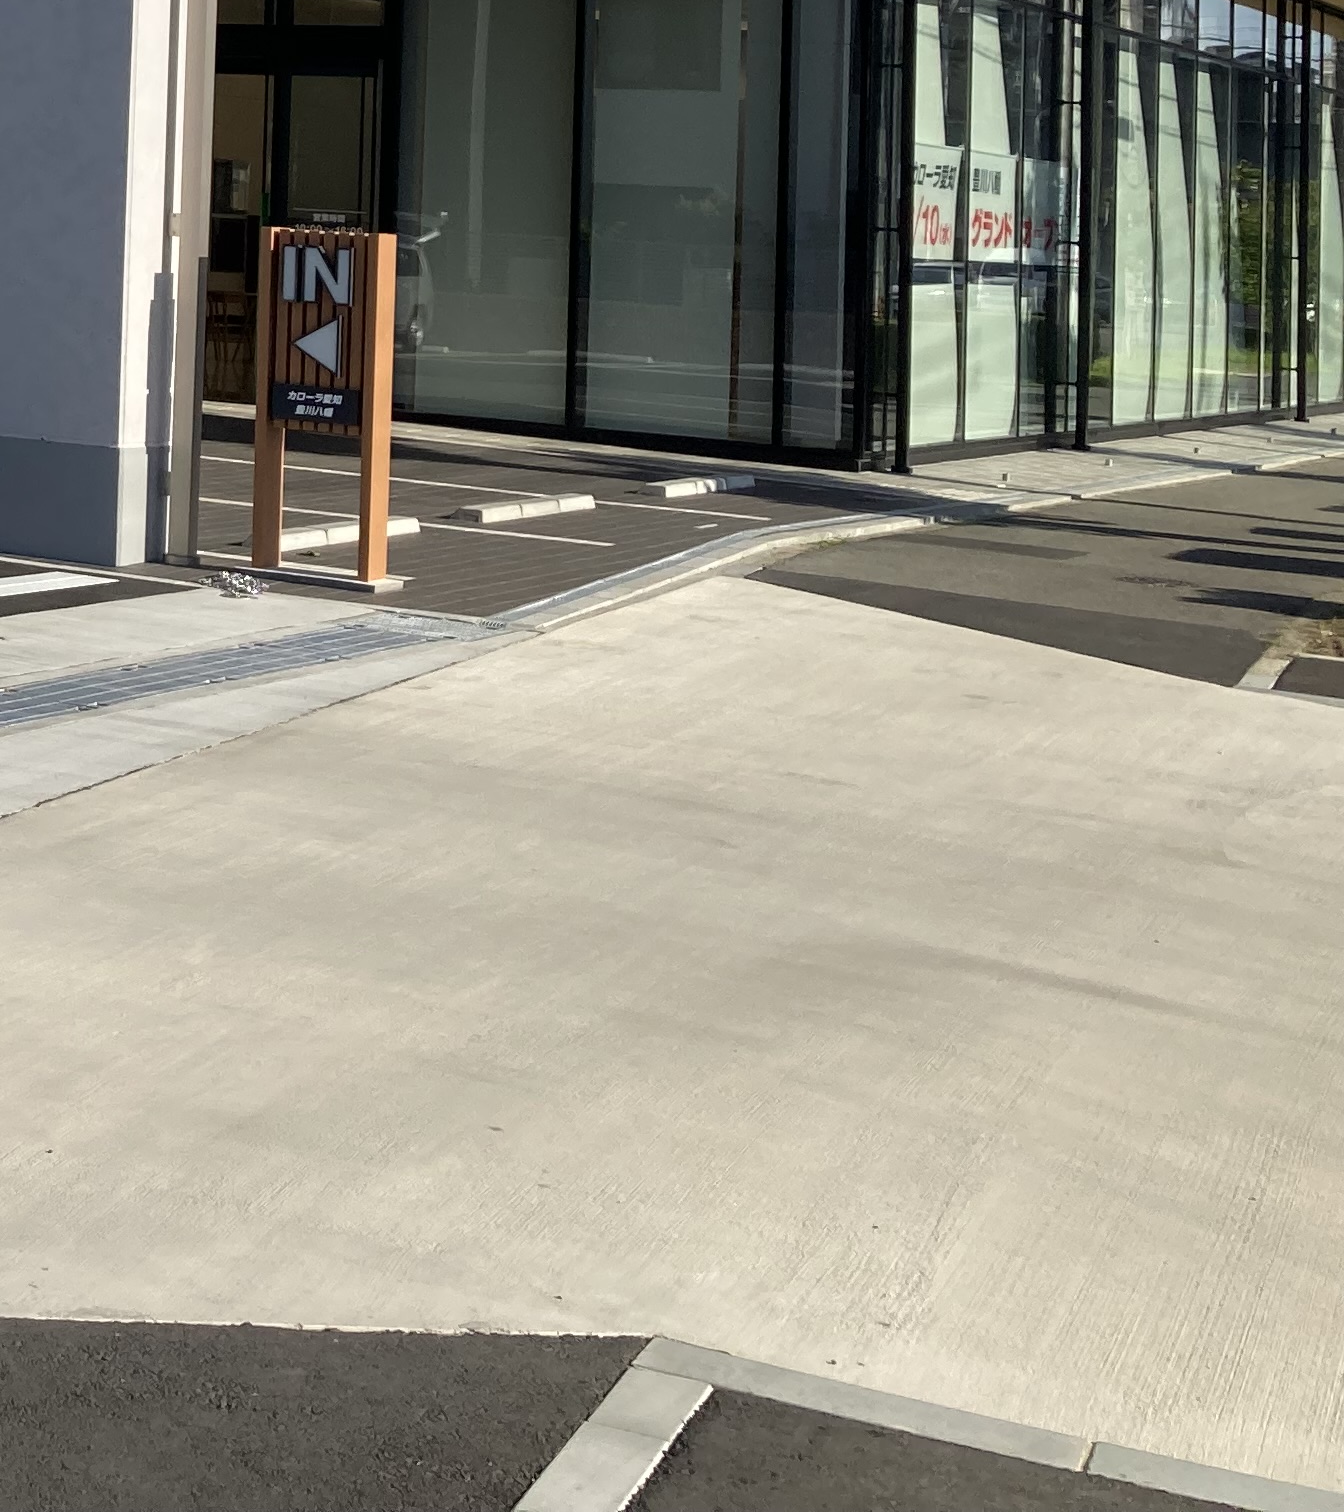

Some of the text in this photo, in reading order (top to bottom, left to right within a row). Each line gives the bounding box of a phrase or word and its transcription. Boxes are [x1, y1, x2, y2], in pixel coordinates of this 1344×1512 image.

[283, 245, 354, 307] IN
[287, 391, 343, 405] カローラ愛知
